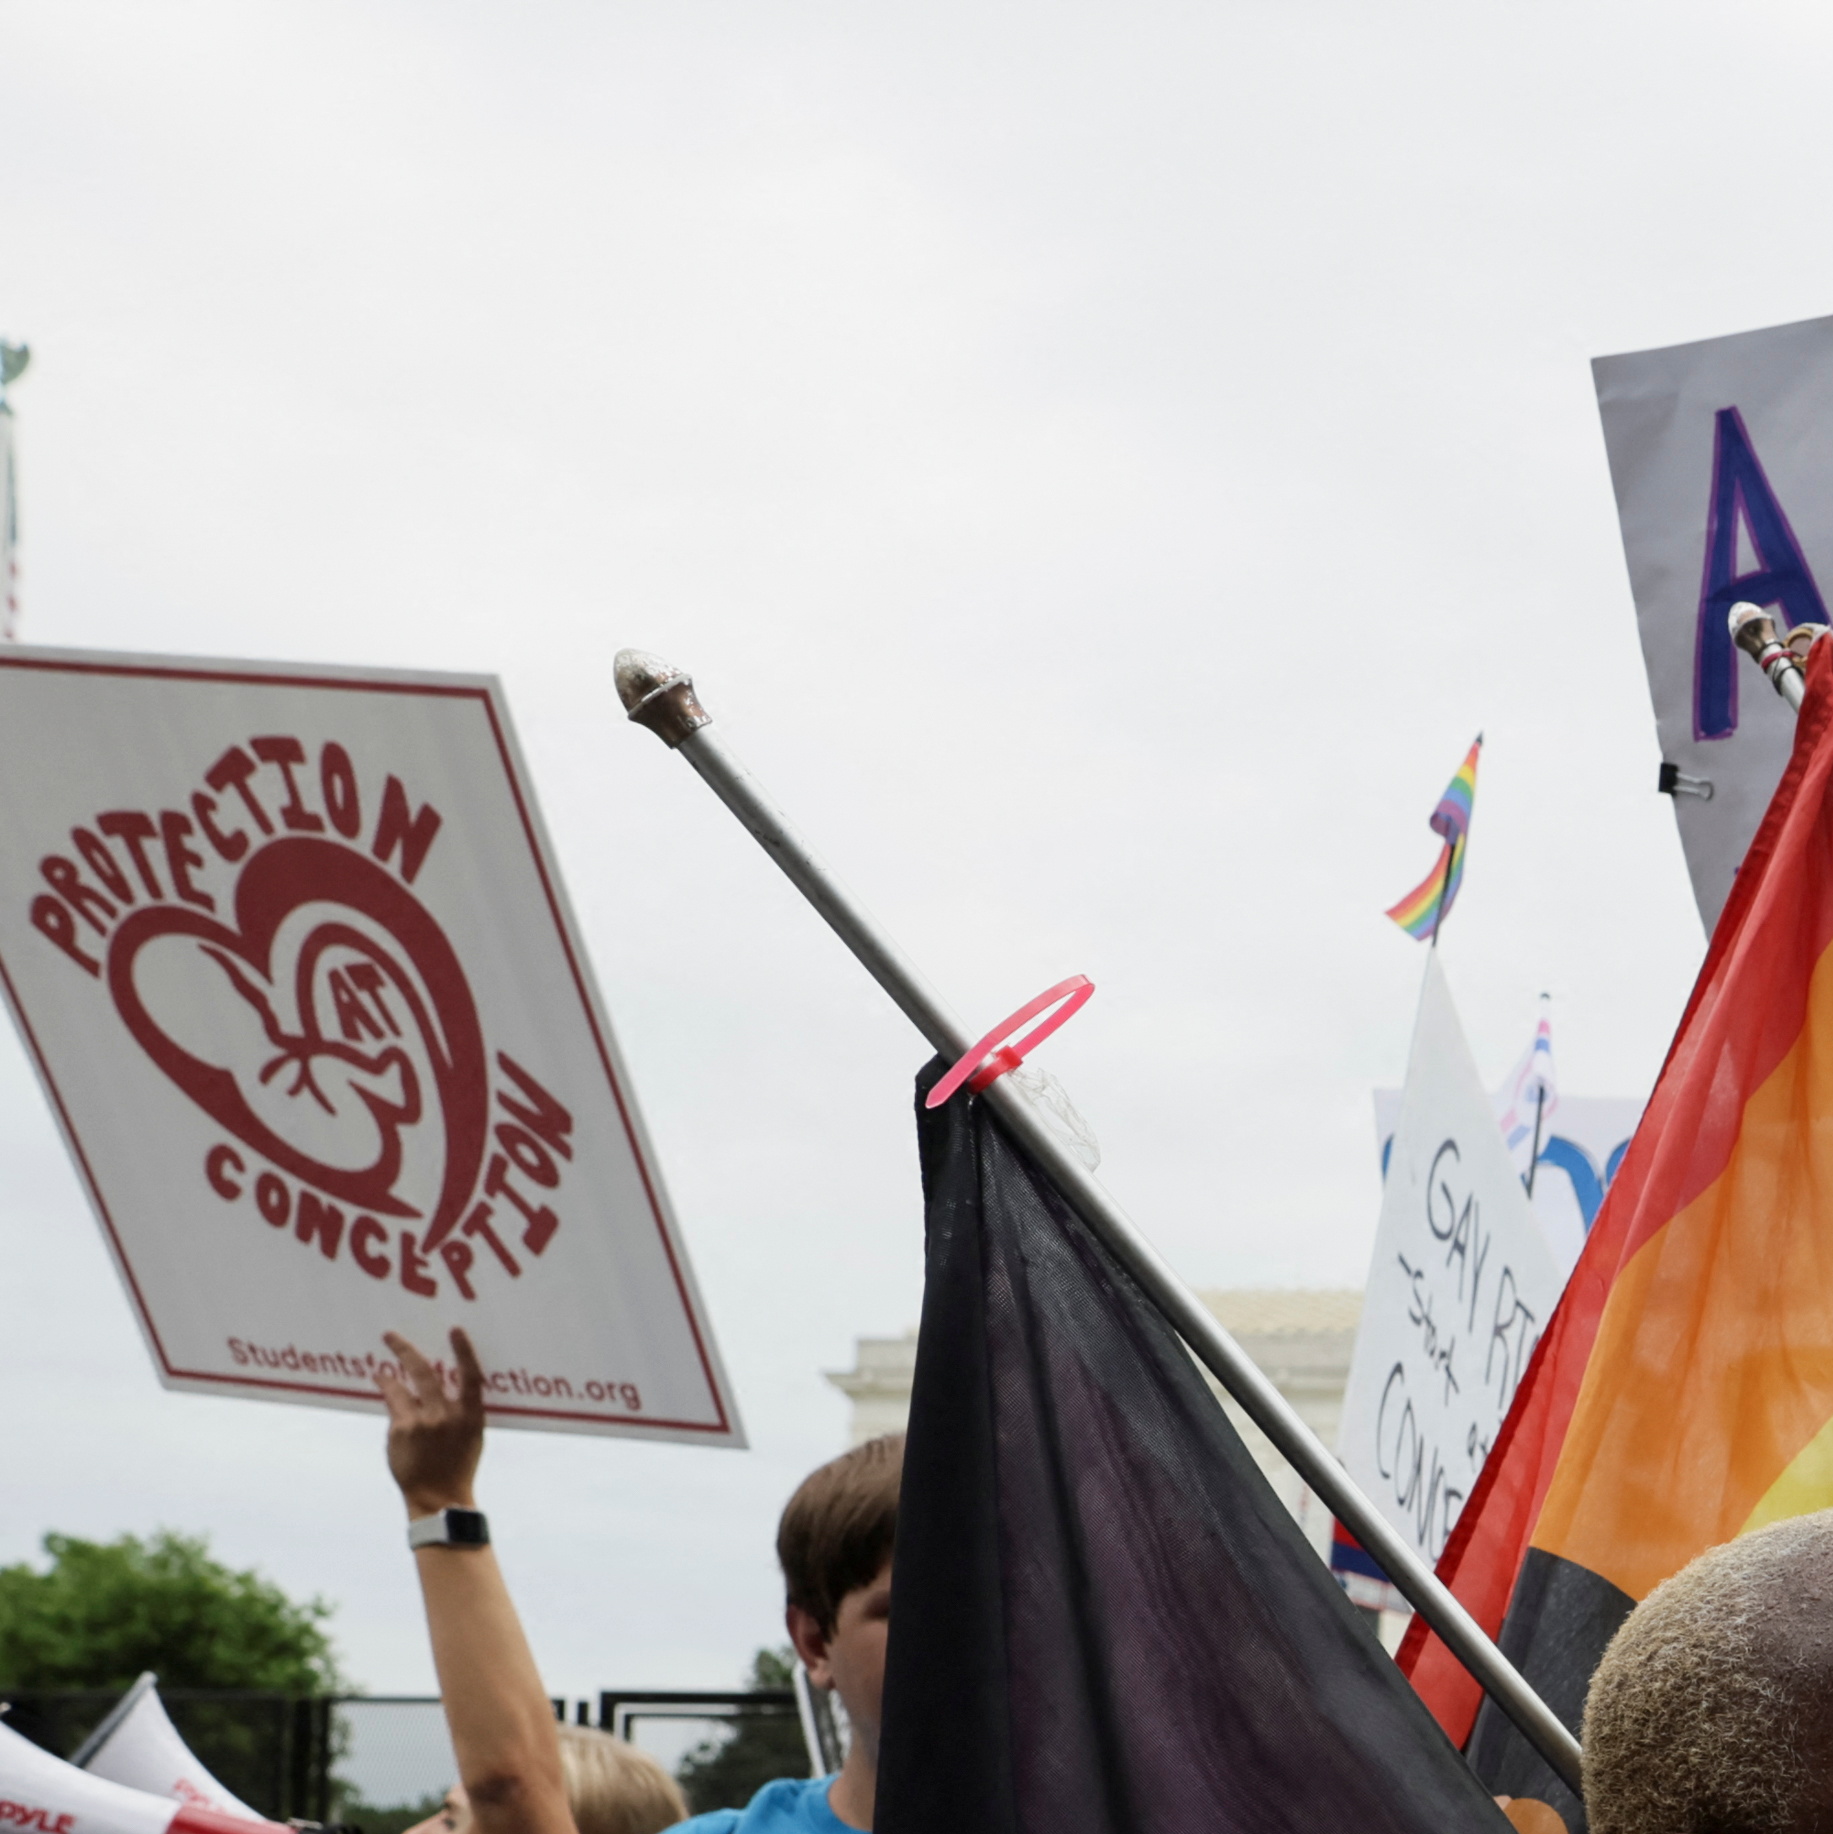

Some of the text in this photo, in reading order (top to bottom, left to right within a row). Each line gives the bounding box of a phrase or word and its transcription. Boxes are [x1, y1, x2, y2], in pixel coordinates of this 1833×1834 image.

[29, 736, 442, 978] PROTECTION
[328, 961, 406, 1043] AT
[205, 1050, 576, 1302] CONCEPTION
[1426, 1138, 1490, 1334] GAY
